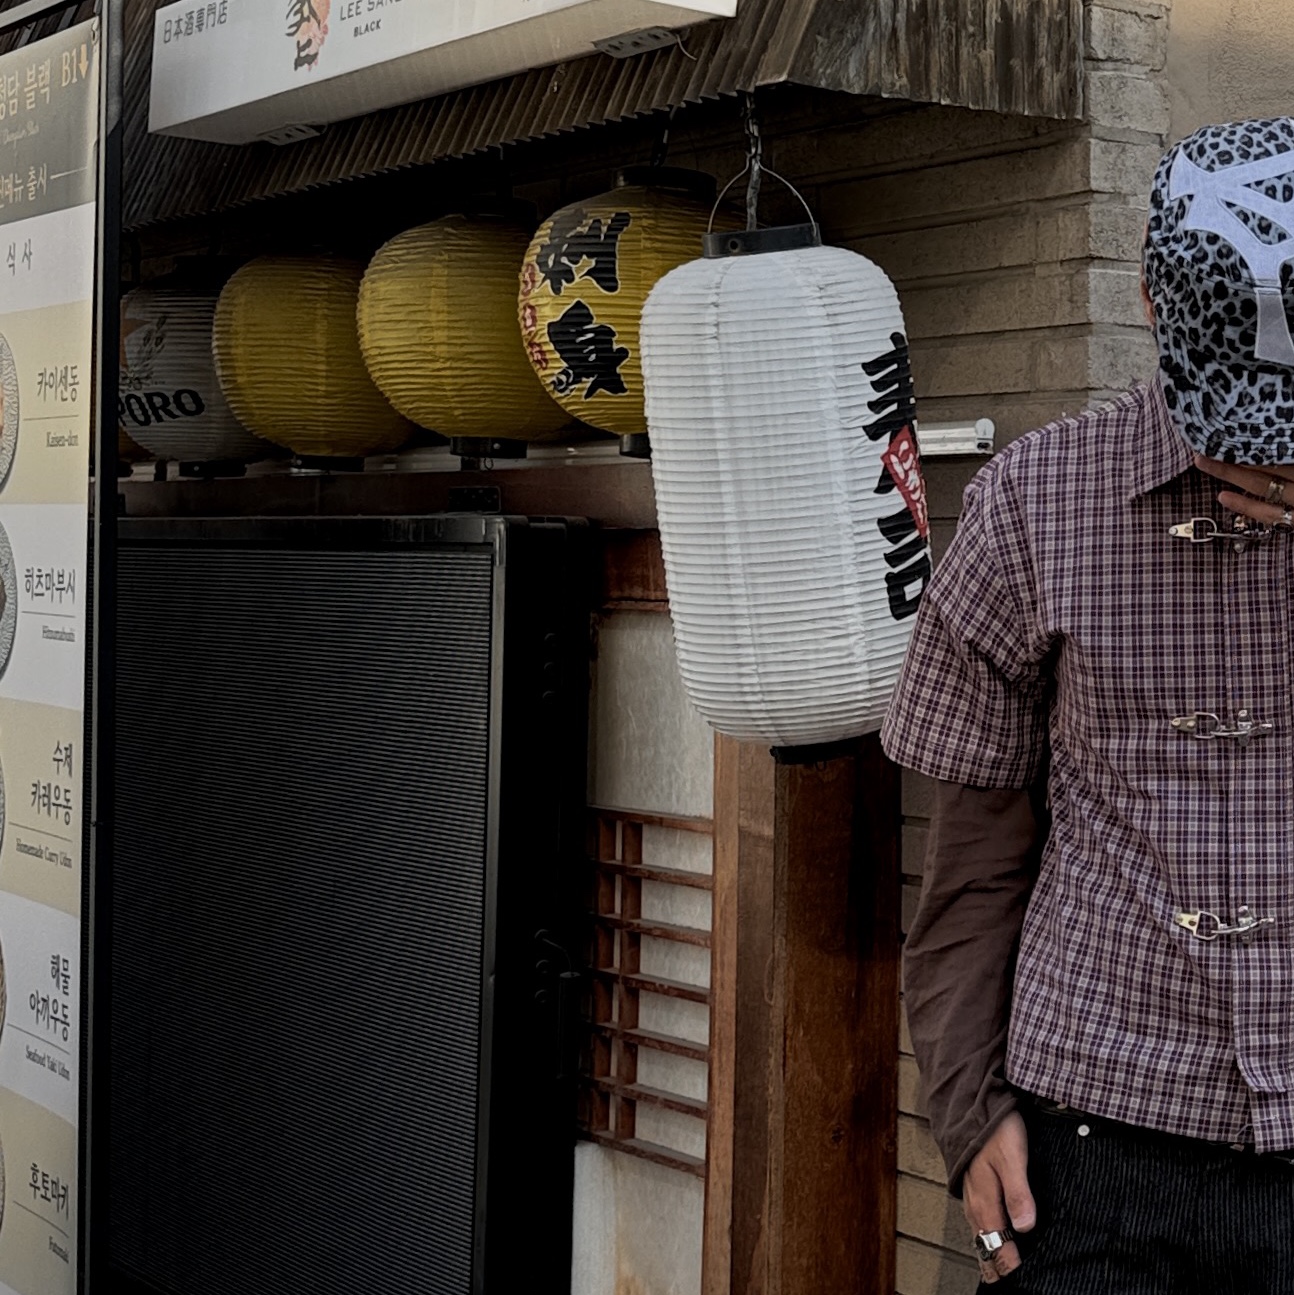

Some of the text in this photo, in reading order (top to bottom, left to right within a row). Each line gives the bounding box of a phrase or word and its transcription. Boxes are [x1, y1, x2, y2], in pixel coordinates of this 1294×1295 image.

[340, 0, 363, 21] LEE
[353, 18, 381, 37] BLACK
[23, 58, 51, 110] 블랙
[61, 47, 78, 87] B1
[26, 163, 47, 201] 출시
[37, 365, 80, 402] 카이센동
[24, 566, 76, 604] 히츠마부시
[52, 740, 73, 778] 수제
[31, 779, 73, 826] 카레우동
[50, 953, 71, 997] 해물
[29, 989, 71, 1043] 야끼우동
[29, 1162, 70, 1221] 후토마키
